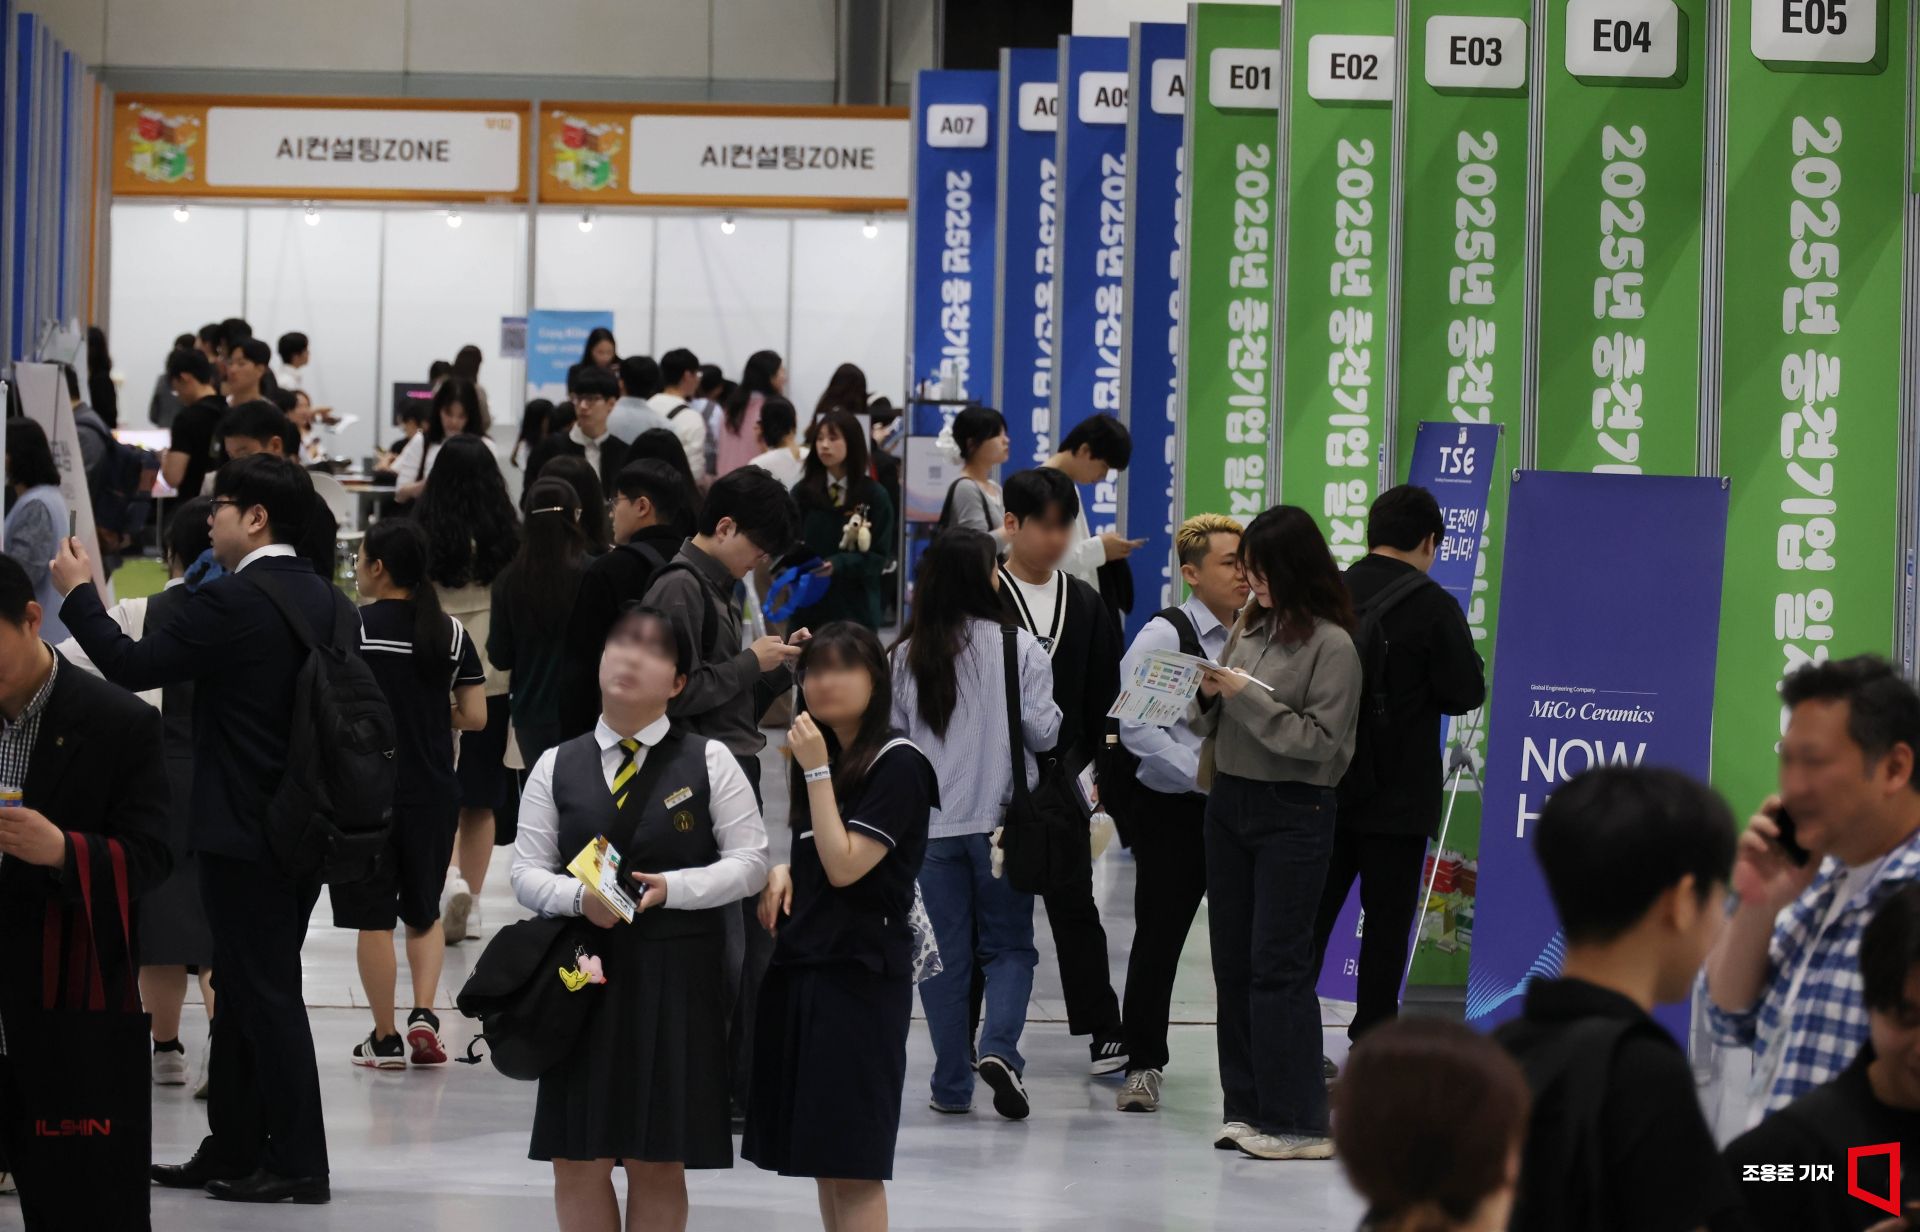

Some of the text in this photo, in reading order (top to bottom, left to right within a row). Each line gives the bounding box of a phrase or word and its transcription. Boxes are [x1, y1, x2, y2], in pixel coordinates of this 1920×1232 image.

[1783, 0, 1846, 35] E05
[1594, 19, 1651, 53] E04
[1450, 36, 1502, 66] E03
[1230, 65, 1271, 90] E01
[1330, 54, 1378, 80] E02
[1033, 97, 1058, 116] A0
[941, 117, 974, 134] A07
[277, 138, 451, 162] AI컨설팅ZONE
[701, 145, 875, 170] AI컨설팅ZONE
[942, 171, 972, 273] 2025년
[1449, 131, 1498, 305] 2025년
[1782, 116, 1842, 335] 2025년
[1590, 125, 1647, 475] 2025년 중견기
[1223, 143, 1270, 530] 2025년 중견기업 일자
[1324, 138, 1375, 570] 2025년 중견기업 일자
[1440, 446, 1475, 476] TSE
[1776, 350, 1841, 572] 중견기업
[1446, 507, 1479, 533] 도전이
[1440, 534, 1475, 562] 됩니다!
[1546, 684, 1573, 694] Engineering
[1573, 686, 1596, 694] Company
[1529, 700, 1655, 724] MiCo Ceramics
[35, 1119, 111, 1137] ILSHIN
